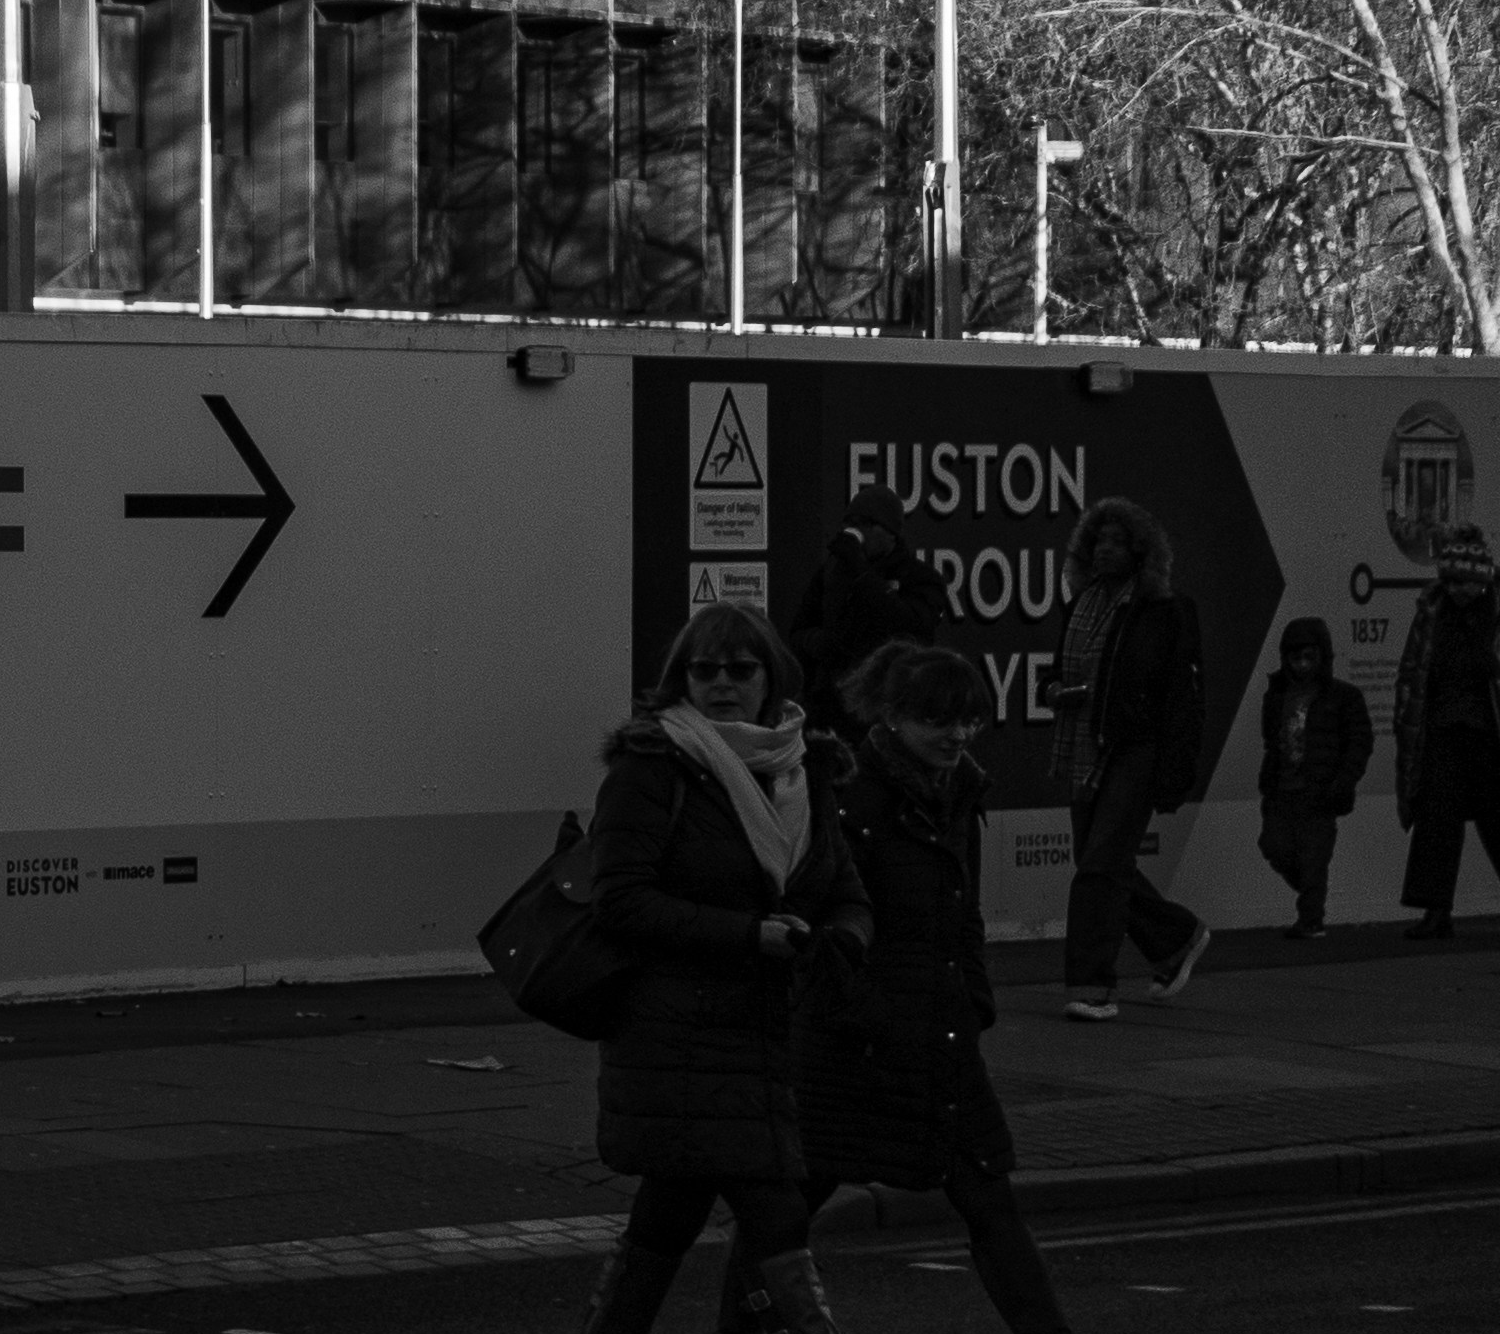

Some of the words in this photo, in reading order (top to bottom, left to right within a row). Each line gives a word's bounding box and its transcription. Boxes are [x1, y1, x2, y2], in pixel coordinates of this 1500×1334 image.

[849, 441, 1085, 515] EUSTON
[1351, 618, 1389, 644] 1837
[7, 858, 79, 873] DISCOVER
[117, 865, 156, 880] mace
[7, 875, 80, 897] EUSTON
